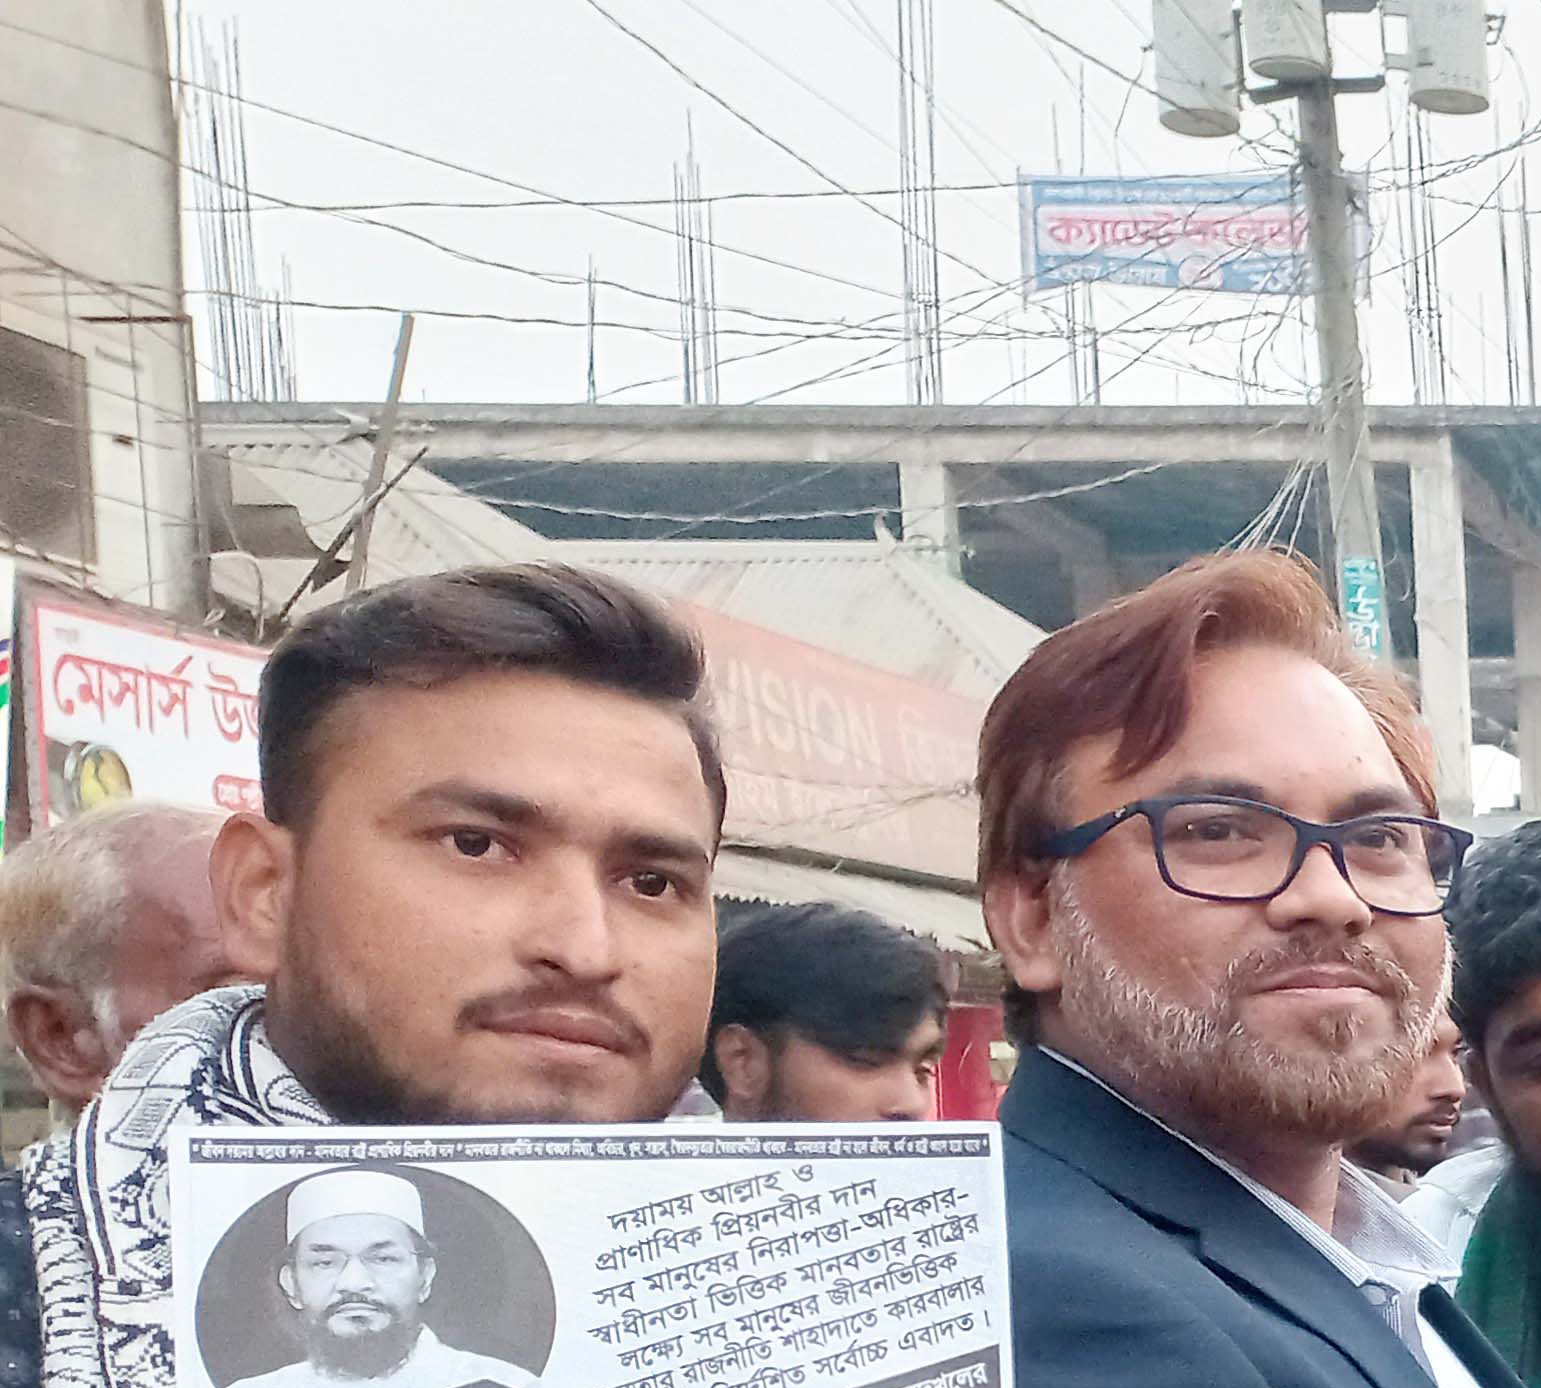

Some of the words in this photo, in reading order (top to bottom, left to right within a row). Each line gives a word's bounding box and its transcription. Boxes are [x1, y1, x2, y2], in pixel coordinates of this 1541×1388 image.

[54, 653, 194, 741] মেসার্স
[592, 1280, 634, 1306] সব
[642, 1251, 737, 1291] মানুষের
[746, 1187, 968, 1265] নিরাপত্তা-অধিকার-
[595, 1226, 701, 1270] প্রাণাধিক
[710, 1193, 820, 1240] প্রিয়নবীর
[828, 1178, 875, 1206] দান
[606, 1193, 692, 1231] দয়াময়
[700, 1171, 783, 1204] আল্লাহ
[792, 1164, 813, 1181] ও
[587, 1296, 696, 1343] স্বাধীনতা
[704, 1271, 786, 1312] ভিত্তিক
[794, 1236, 905, 1282] মানবতার
[913, 1213, 978, 1247] রাষ্ট্রের
[616, 1335, 682, 1369] লক্ষ্যে
[690, 1321, 727, 1345] সব
[735, 1294, 819, 1333] মানুষের
[825, 1251, 956, 1304] জীবনভিত্তিক
[680, 1336, 771, 1383] রাজনীতি
[780, 1308, 877, 1351] শাহাদাতে
[884, 1275, 984, 1319] কারবালার
[813, 1339, 887, 1375] সর্বোচ্চ
[898, 1312, 973, 1349] এবাদত
